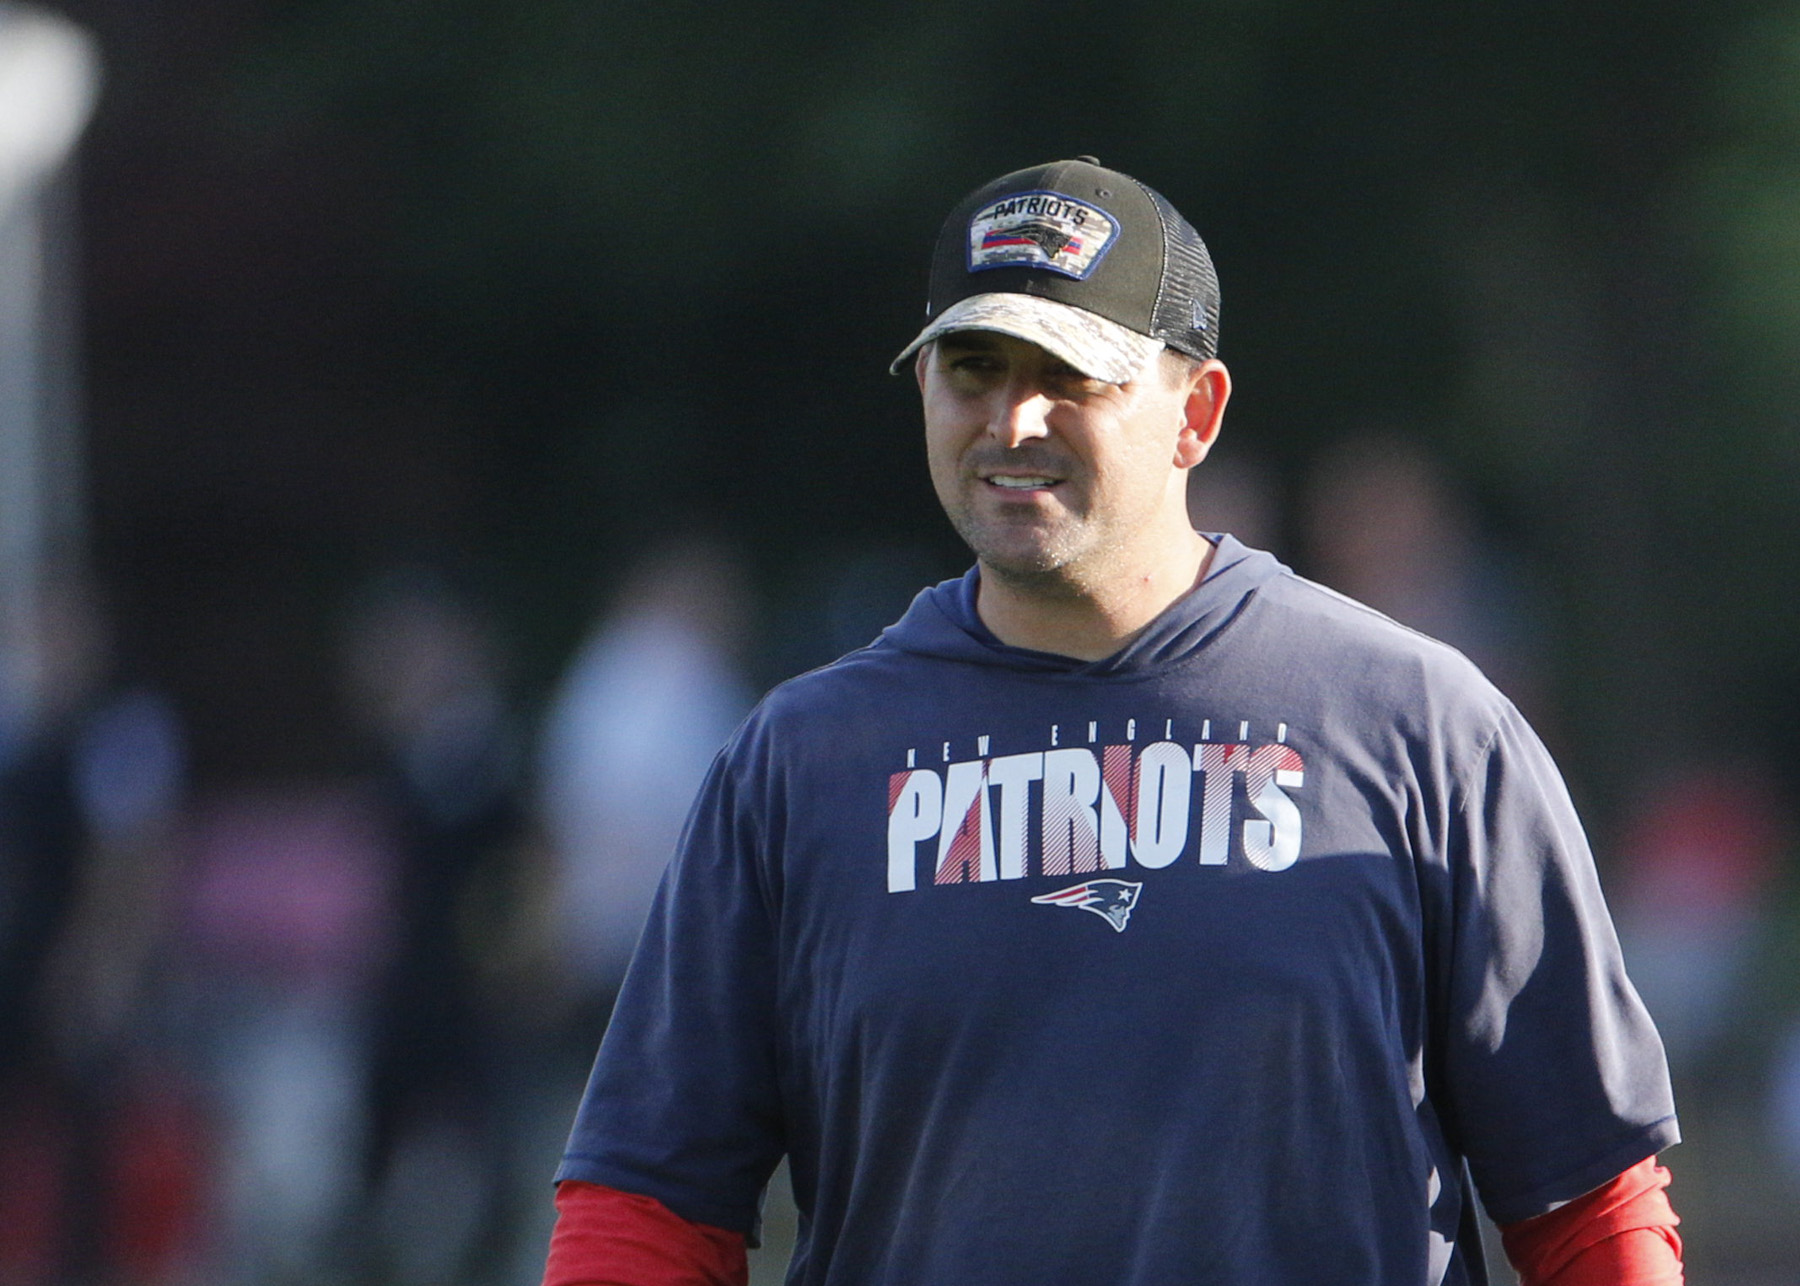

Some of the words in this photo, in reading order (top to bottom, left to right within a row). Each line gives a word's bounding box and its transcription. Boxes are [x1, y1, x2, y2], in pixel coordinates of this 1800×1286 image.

[994, 197, 1089, 226] PATRIOTS
[906, 735, 990, 769] NEW
[1050, 718, 1287, 747] ENGLAND
[888, 741, 1304, 894] PATRIOTS
